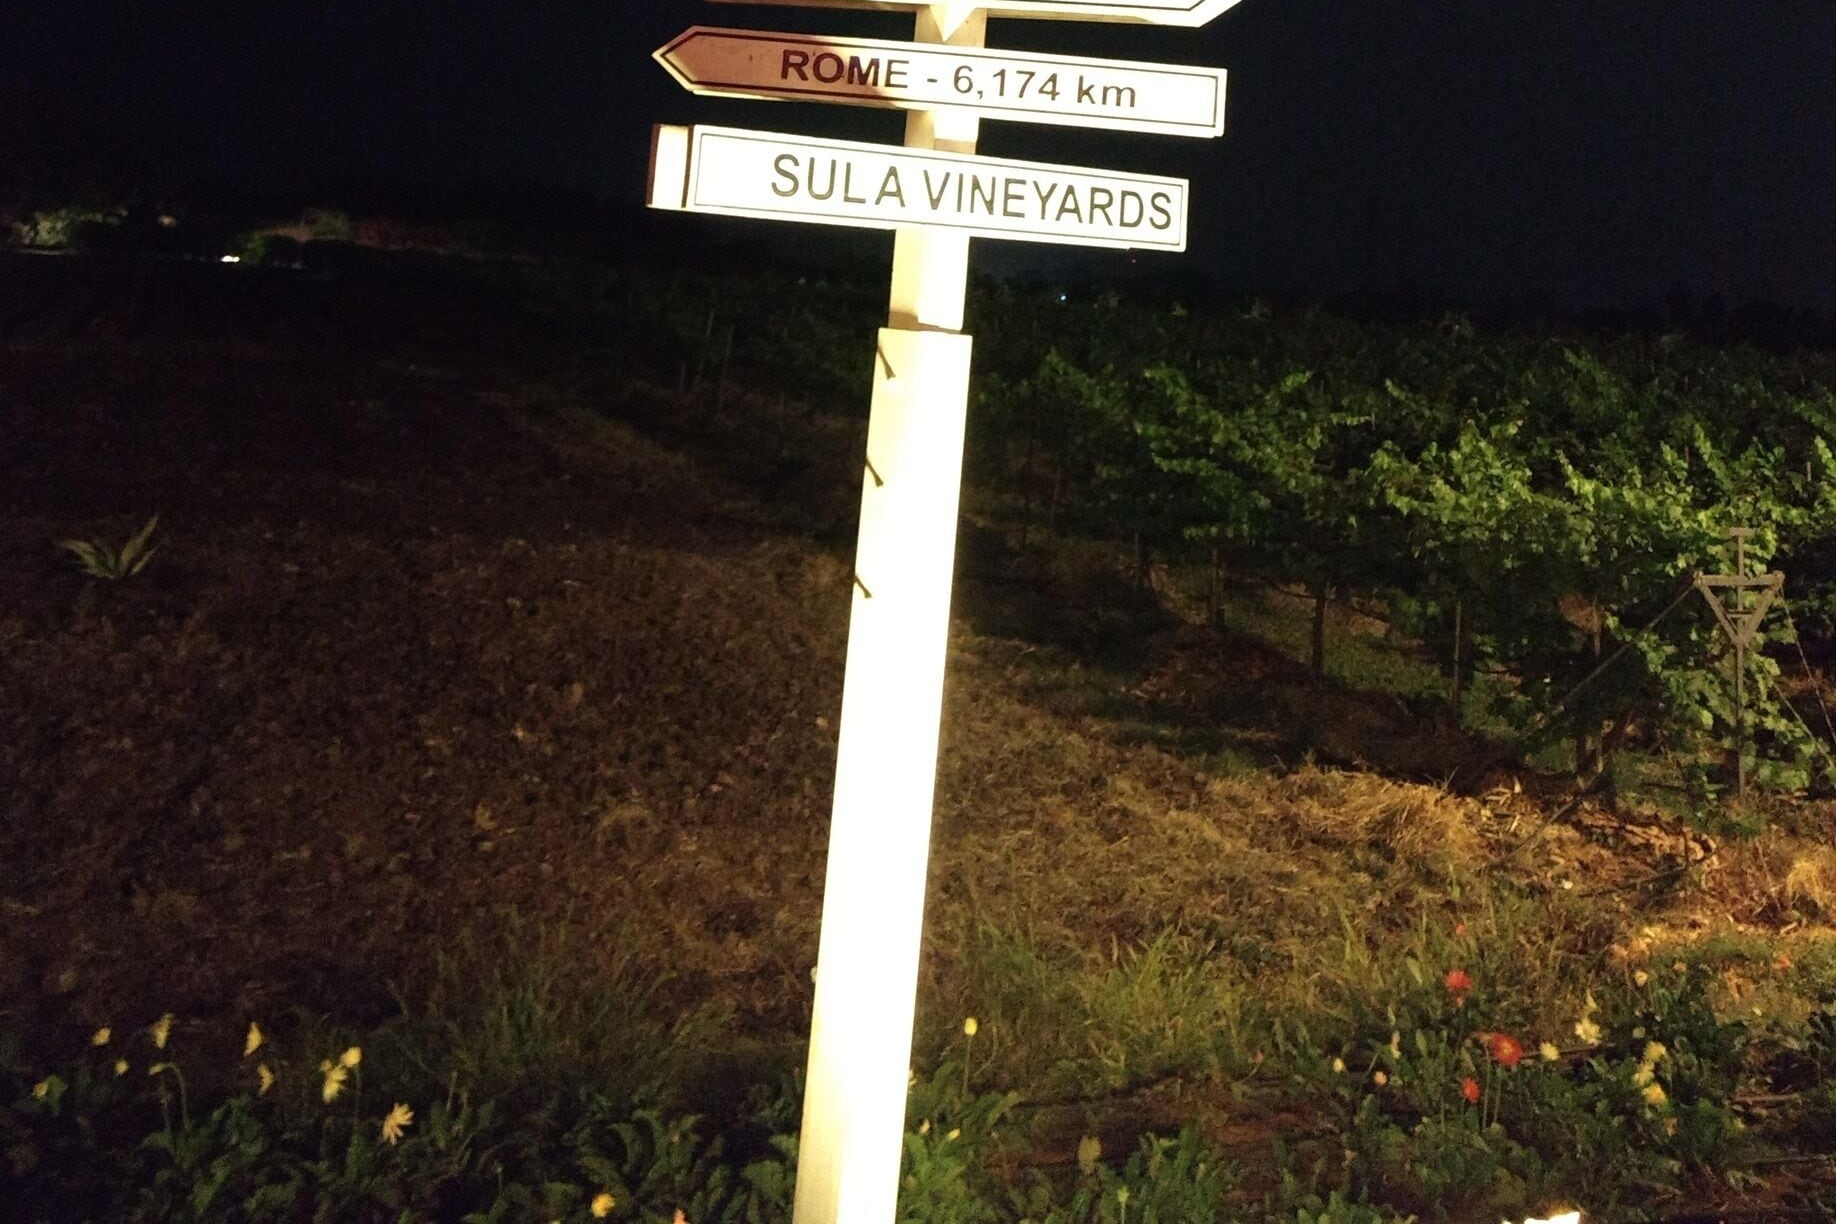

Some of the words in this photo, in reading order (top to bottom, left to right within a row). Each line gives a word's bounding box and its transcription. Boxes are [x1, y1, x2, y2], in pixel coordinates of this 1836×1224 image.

[779, 48, 910, 89] ROME
[954, 65, 1059, 102] 6,174
[1077, 74, 1136, 108] km
[771, 153, 906, 209] SULA
[922, 168, 1173, 232] VINEYARDS
